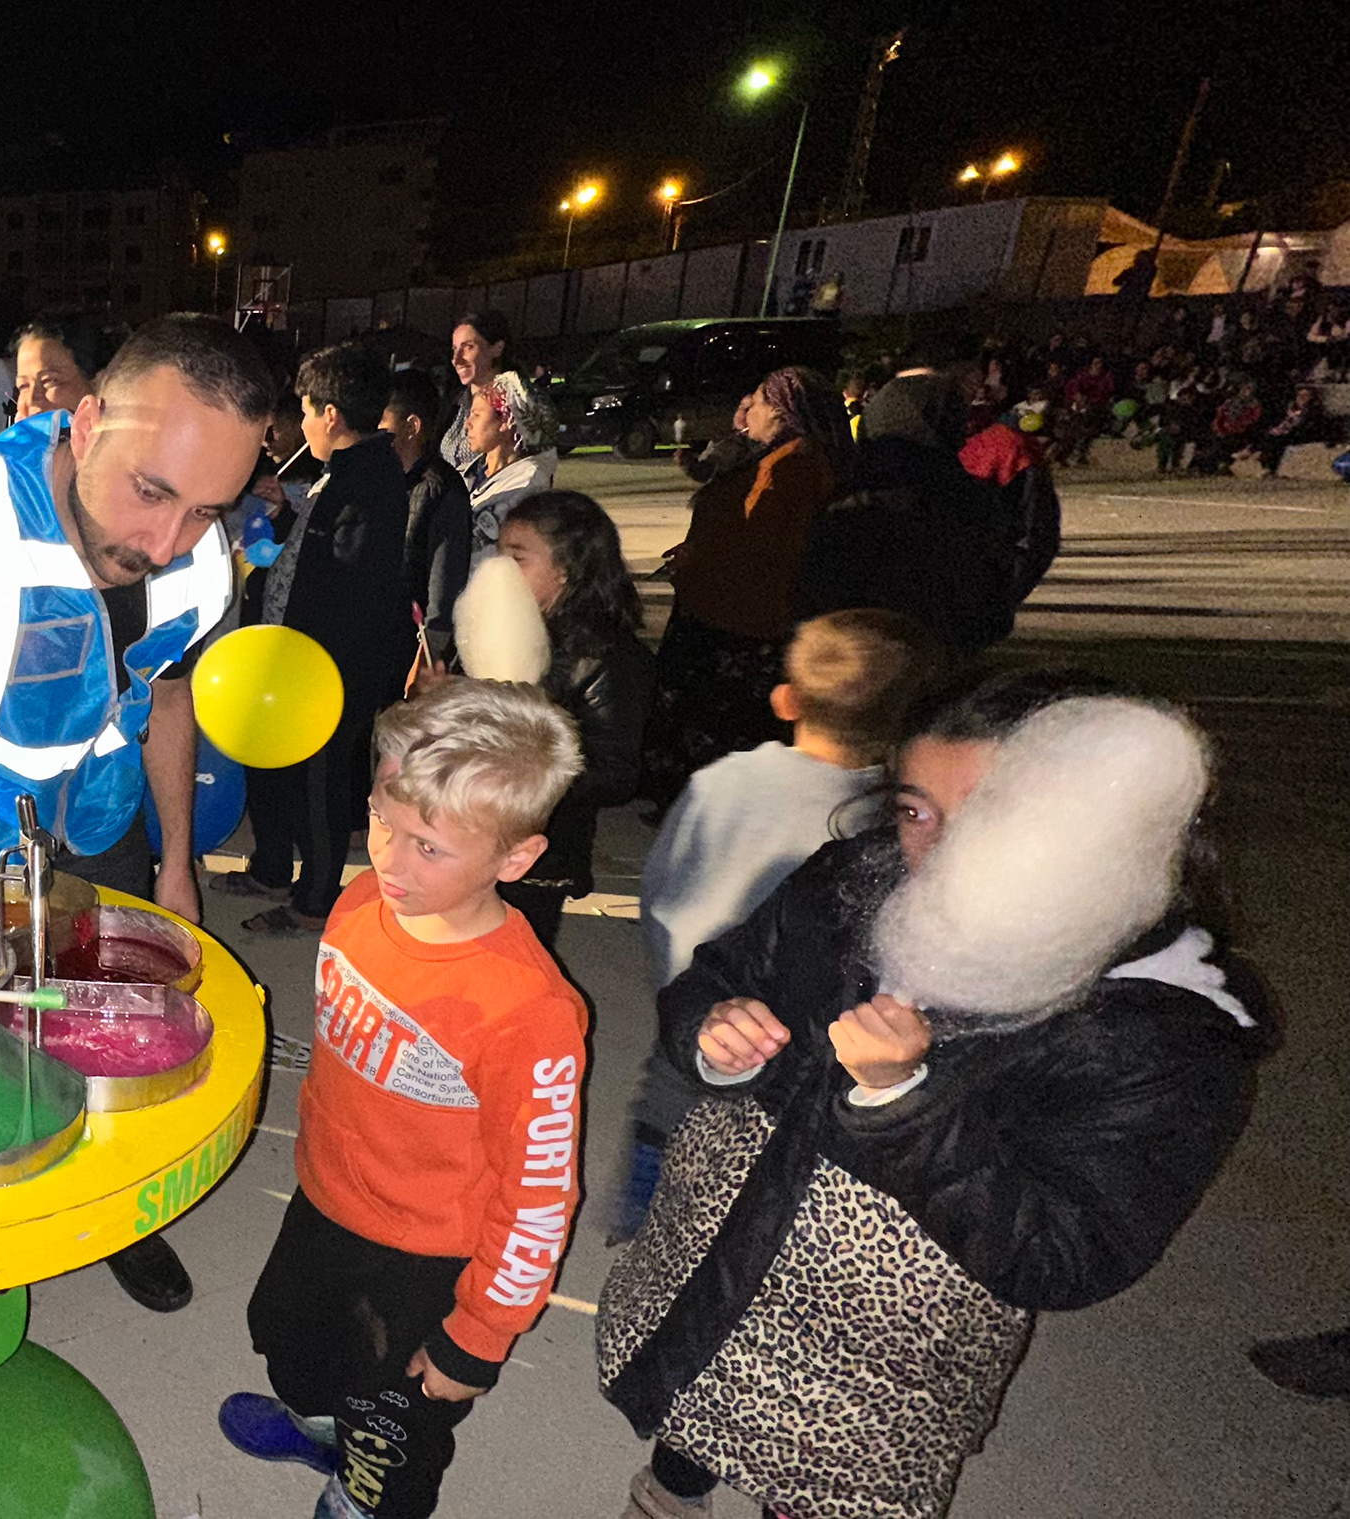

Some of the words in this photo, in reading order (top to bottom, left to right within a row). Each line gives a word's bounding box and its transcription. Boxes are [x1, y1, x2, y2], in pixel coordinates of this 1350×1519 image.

[401, 1049, 420, 1064] one
[422, 1060, 434, 1069] of
[396, 1067, 435, 1088] Cancer
[392, 1078, 454, 1105] Consortium
[521, 1055, 577, 1192] SPORT
[484, 1201, 565, 1307] WEAR
